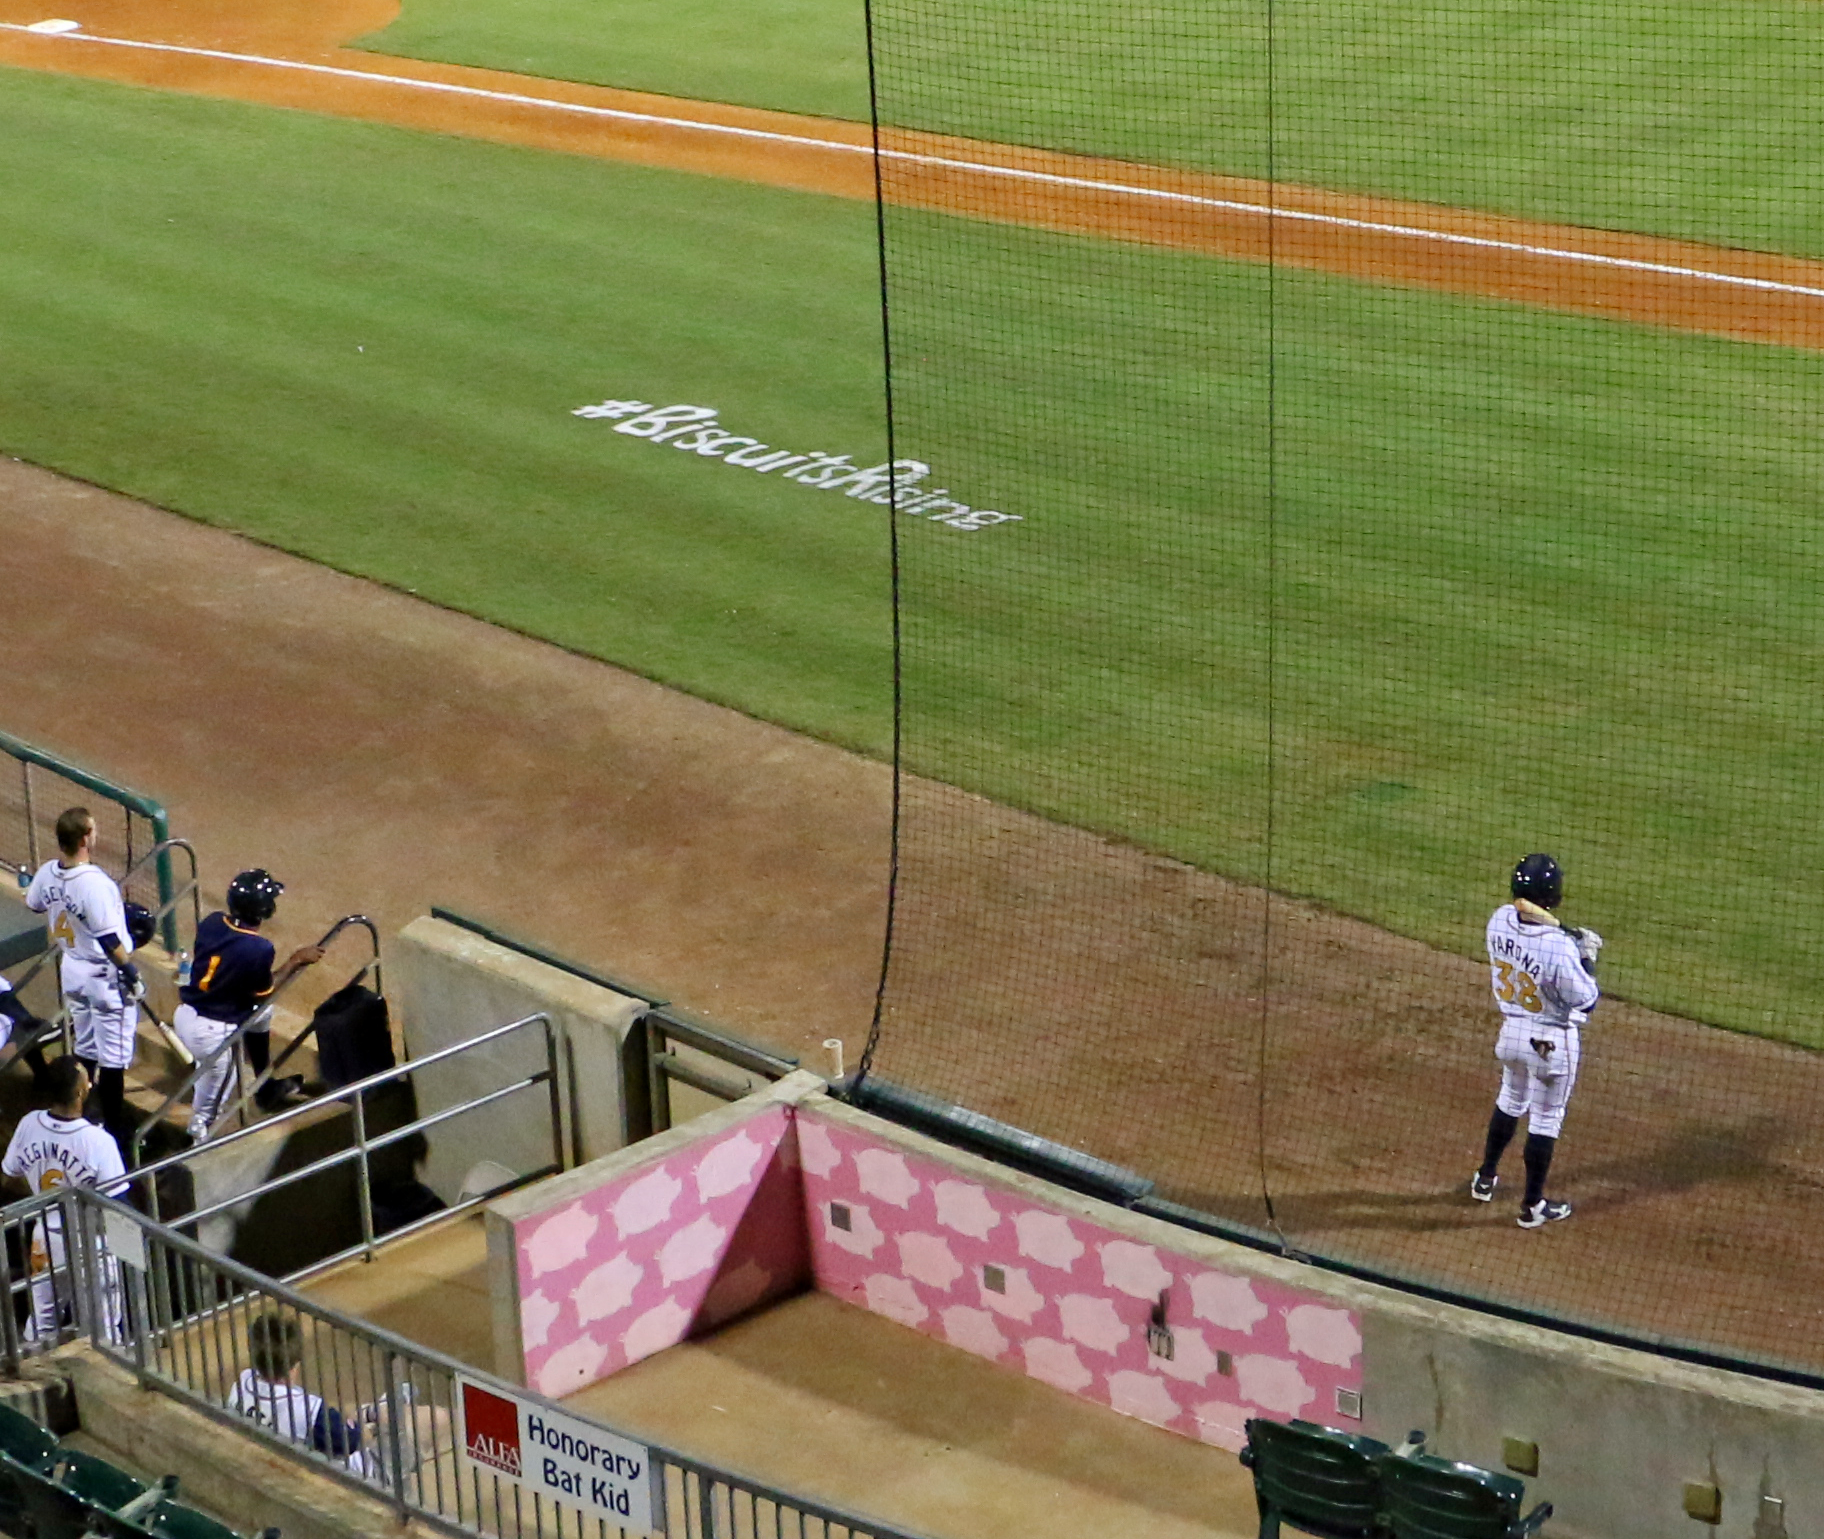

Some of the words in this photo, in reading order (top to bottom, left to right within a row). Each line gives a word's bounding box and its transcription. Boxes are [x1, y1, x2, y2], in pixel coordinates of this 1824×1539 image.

[572, 400, 1023, 531] #BiscuitsRising
[53, 912, 75, 948] 4
[199, 955, 221, 991] 1
[474, 1434, 521, 1466] ALFA
[528, 1414, 640, 1480] Honorary
[543, 1458, 582, 1497] Bat
[592, 1477, 630, 1516] Kid
